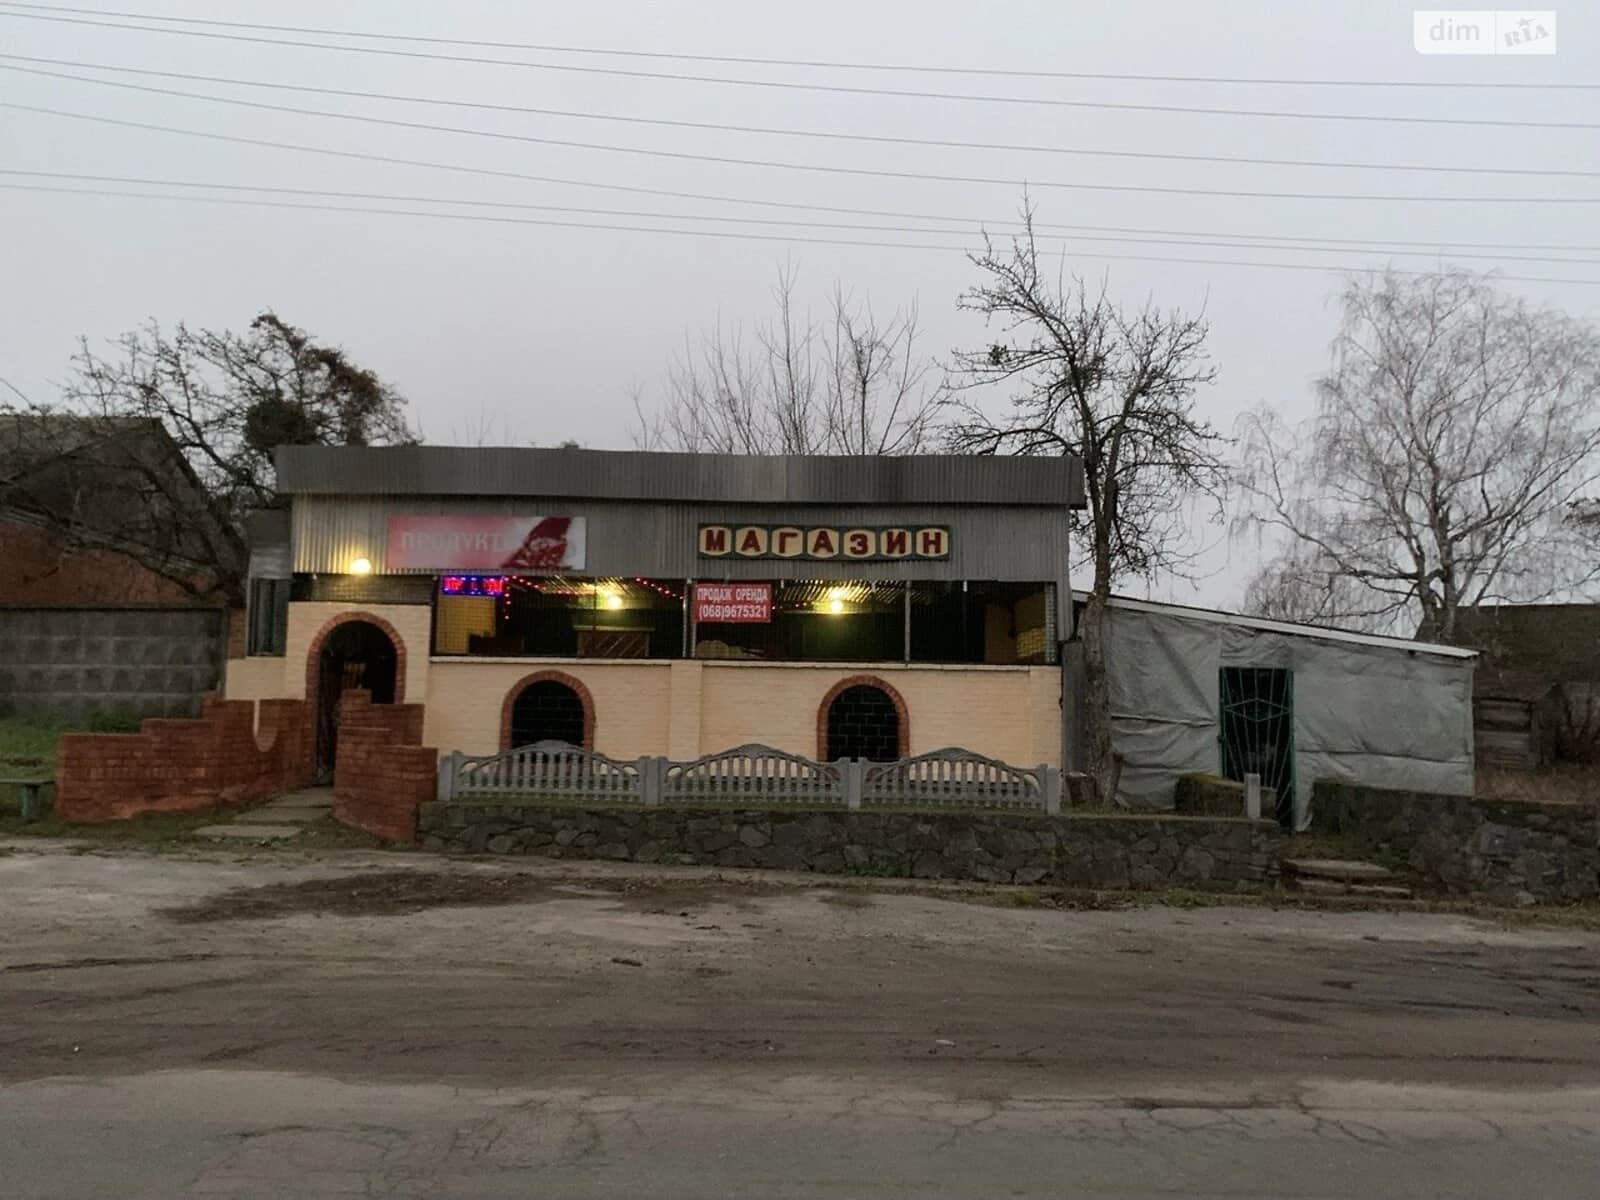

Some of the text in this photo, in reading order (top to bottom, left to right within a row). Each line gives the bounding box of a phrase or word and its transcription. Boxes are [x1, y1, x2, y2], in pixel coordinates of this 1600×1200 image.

[705, 529, 942, 556] МАГАЗИН
[697, 587, 768, 603] ПРОДАЖ ОРЕНДА
